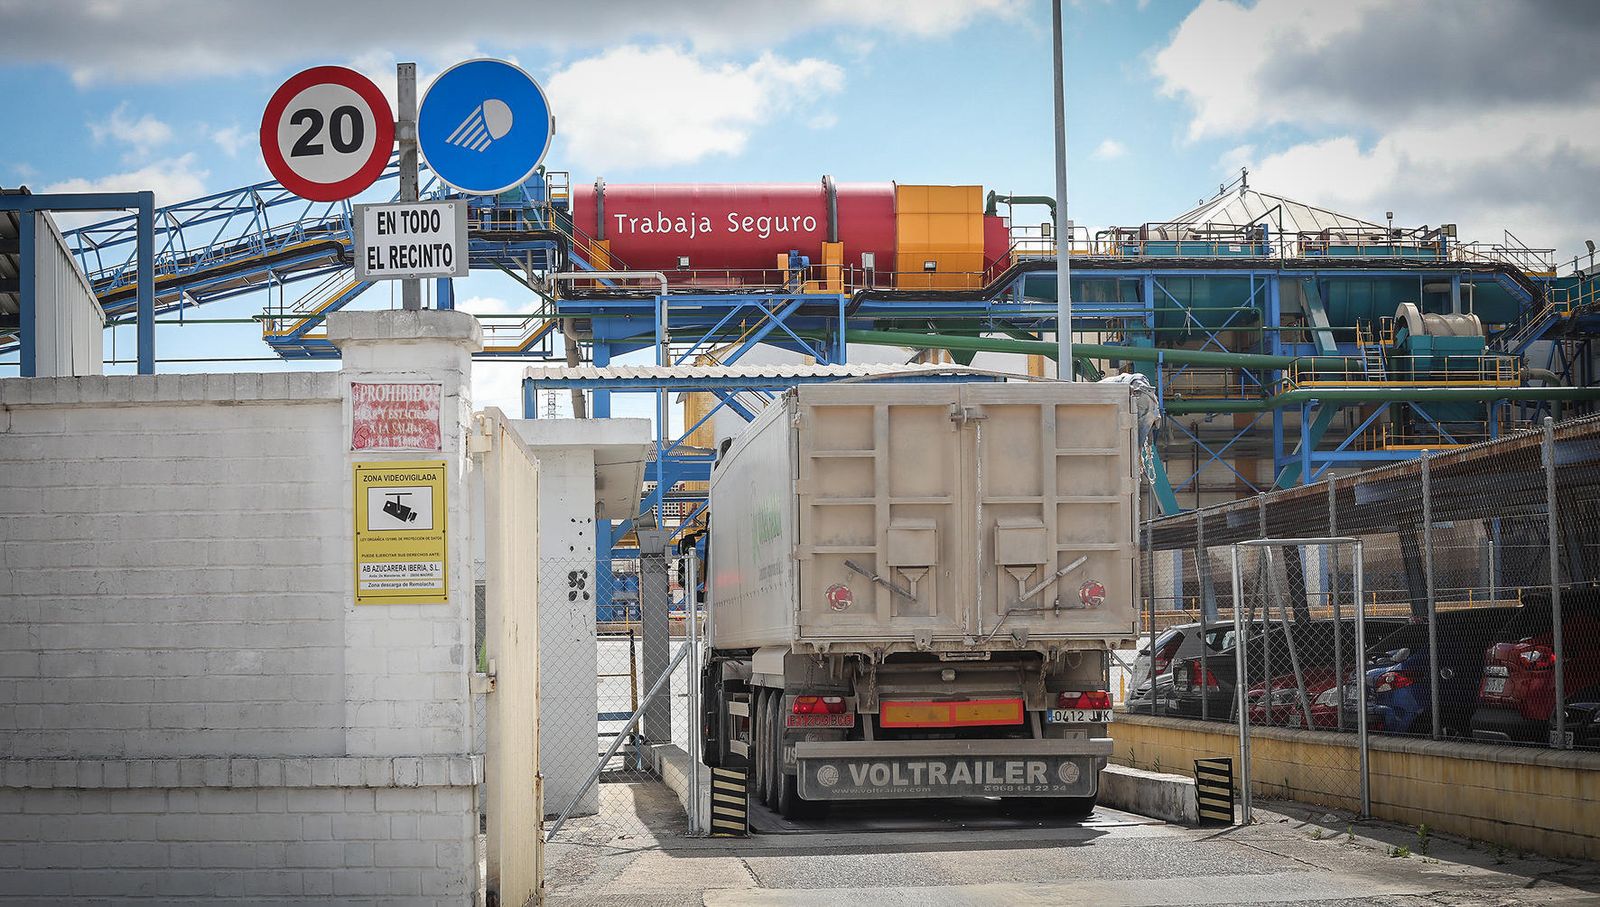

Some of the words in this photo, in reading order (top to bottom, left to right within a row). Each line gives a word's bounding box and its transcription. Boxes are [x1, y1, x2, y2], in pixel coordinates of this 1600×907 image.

[290, 105, 365, 157] 20
[377, 211, 396, 236] EN
[401, 209, 440, 234] TODO
[614, 211, 712, 239] Trabaja
[727, 212, 817, 238] Seguro
[368, 246, 385, 270] EL
[389, 243, 453, 269] RECINTO
[360, 384, 433, 402] PROHIBIDO
[363, 474, 383, 482] ZONA
[384, 473, 437, 482] VIDEOVIGILADA
[362, 565, 371, 573] AB
[372, 564, 407, 573] AZUCARERA
[407, 564, 428, 573] IBERIA,
[1054, 710, 1084, 722] 0412
[848, 761, 1048, 786] VOLTRAILER
[831, 786, 932, 794] www.voltrailer.com
